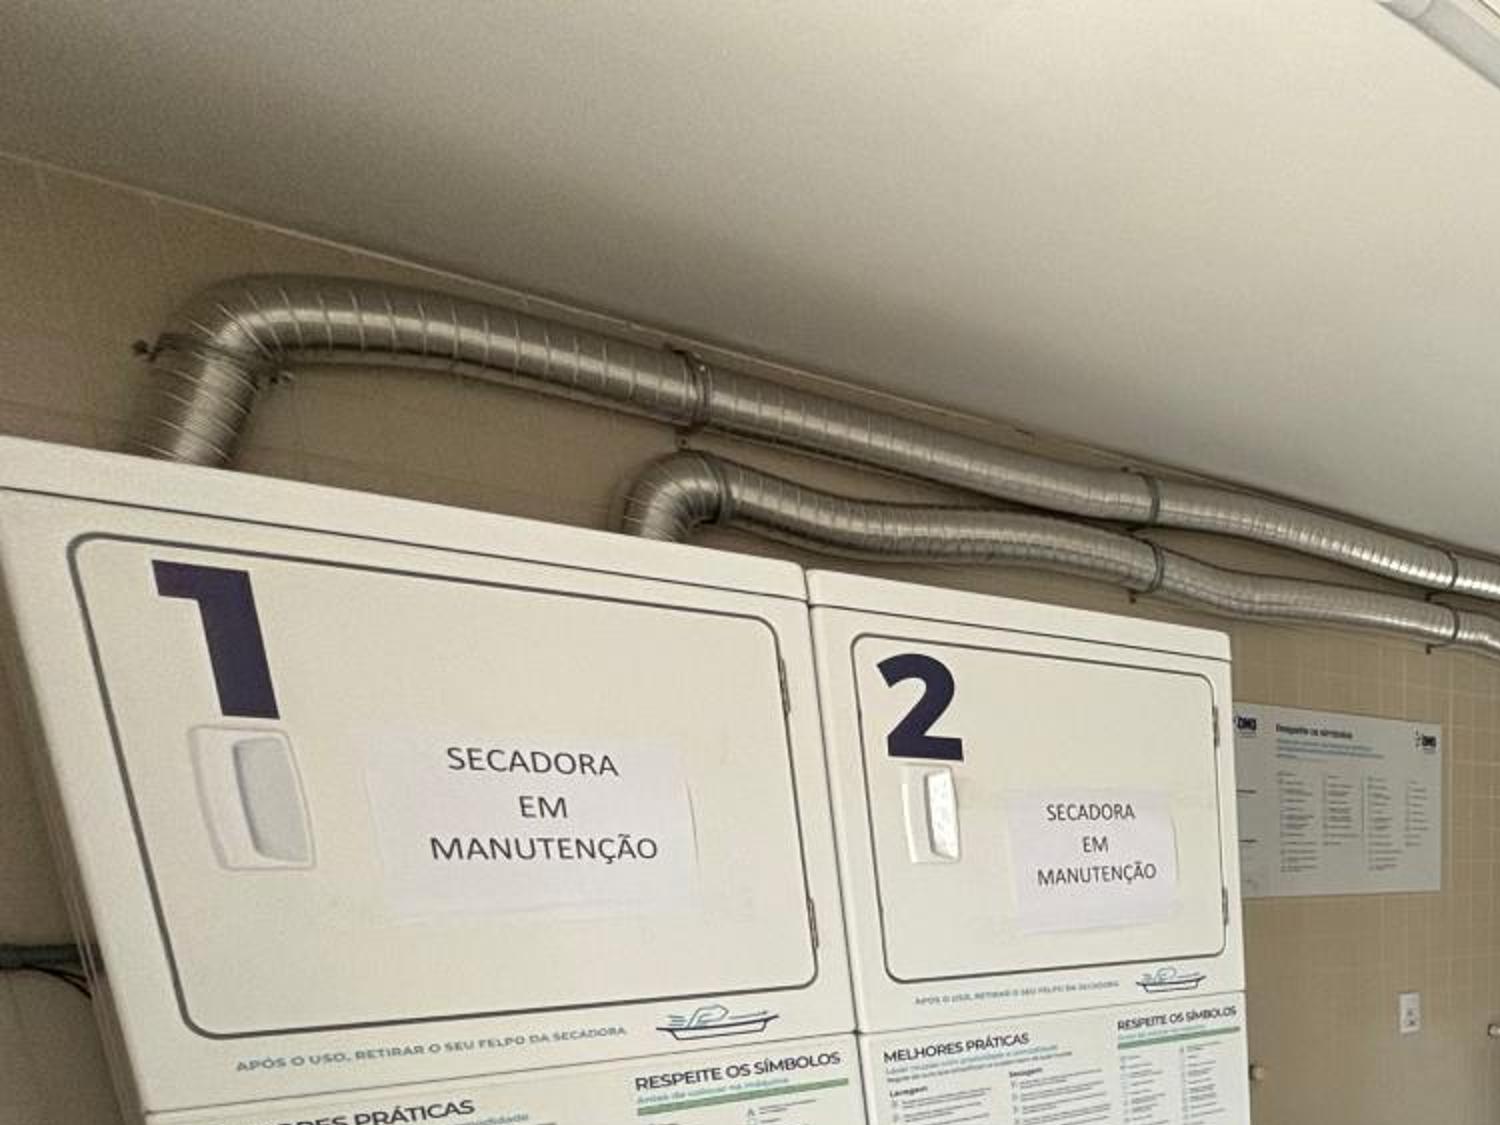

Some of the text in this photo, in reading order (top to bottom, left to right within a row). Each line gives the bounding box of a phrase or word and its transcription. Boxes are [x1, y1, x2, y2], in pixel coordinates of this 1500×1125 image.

[152, 559, 280, 719] 1
[877, 652, 964, 761] 2
[447, 745, 619, 778] SECADORA
[519, 796, 568, 820] EM
[1046, 803, 1136, 822] SECADORA
[430, 833, 658, 866] MANUTENÇÃO
[1082, 836, 1109, 853] EM
[1037, 860, 1157, 887] MANUTENÇÃO
[1169, 1011, 1184, 1024] OS
[236, 1025, 627, 1072] APÓS O USO, RETIRAR O SEU FELPO DA SECADORA
[884, 1032, 1030, 1063] MELHORES PRÁTICAS
[635, 1051, 841, 1090] RESPEITE OS SÍMBOLOS
